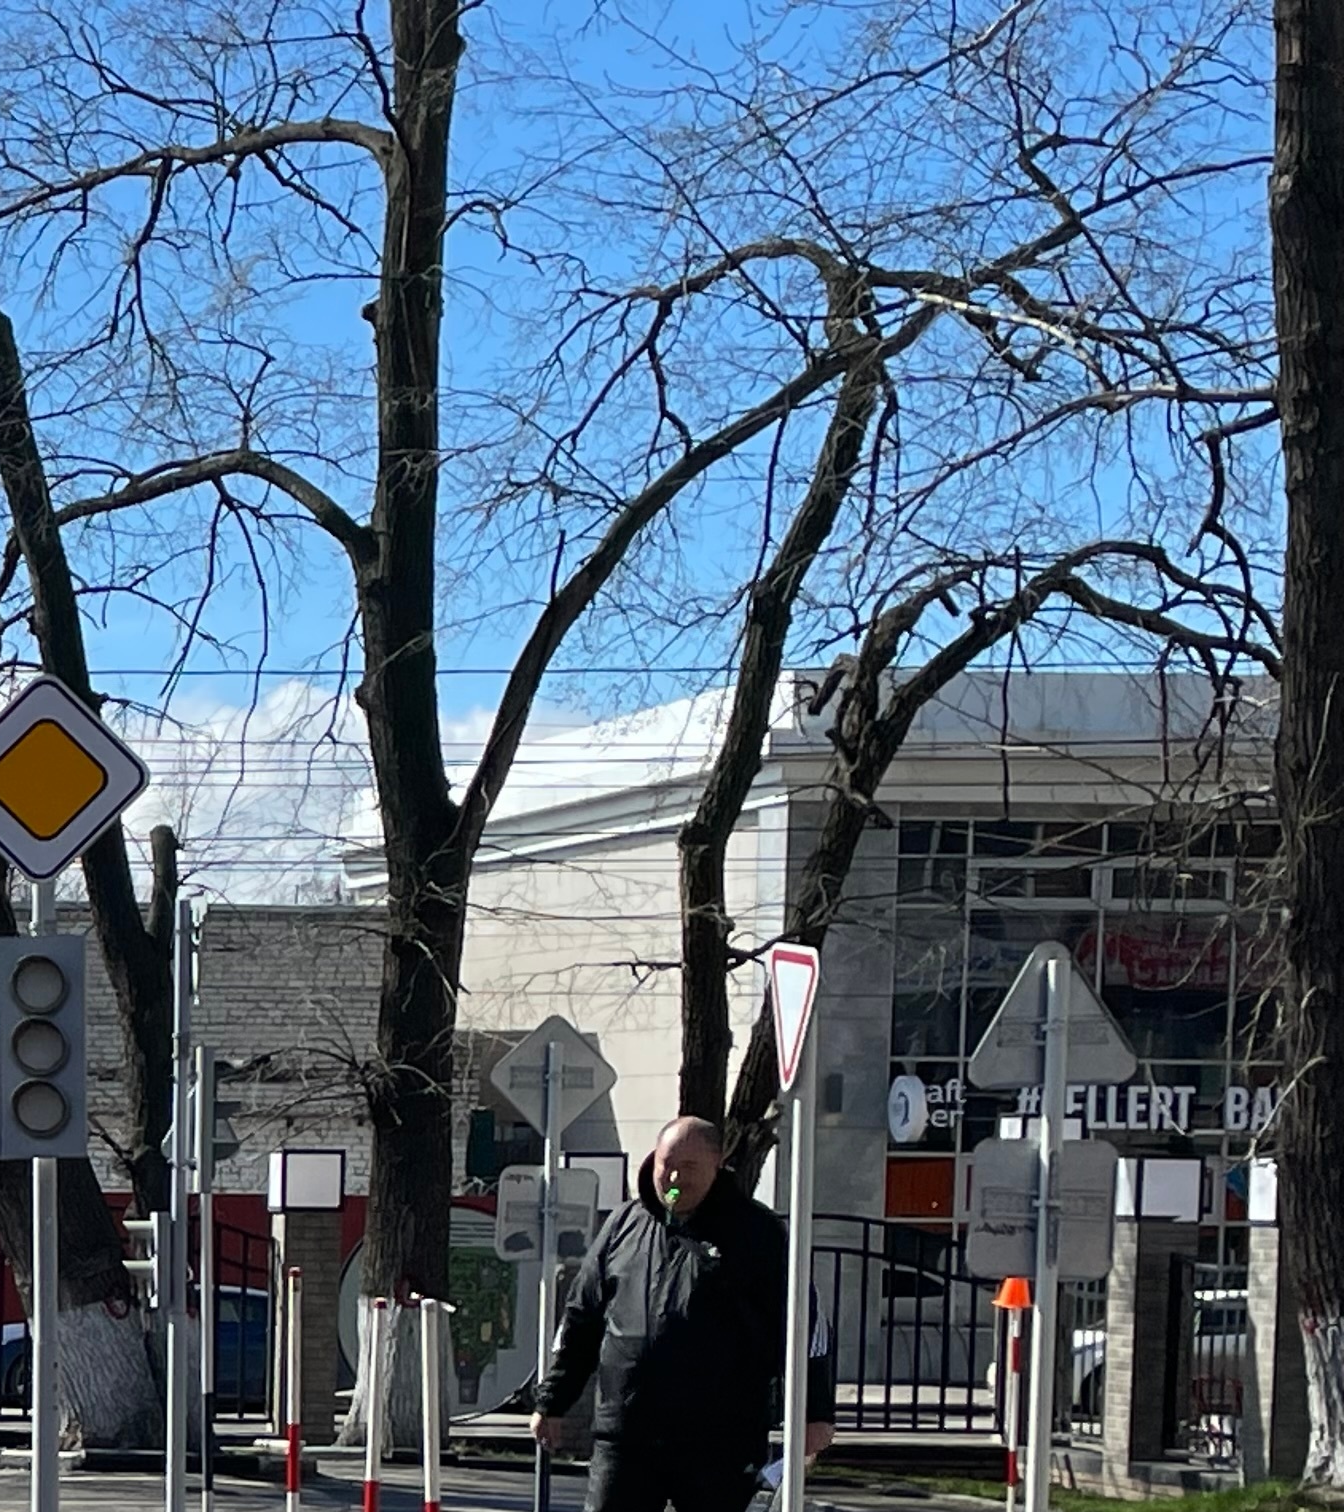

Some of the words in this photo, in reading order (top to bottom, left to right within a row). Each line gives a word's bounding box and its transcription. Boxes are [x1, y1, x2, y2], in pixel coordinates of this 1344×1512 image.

[924, 1078, 967, 1103] aft
[924, 1109, 964, 1128] er
[1016, 1085, 1196, 1130] #ELLERT
[1223, 1085, 1282, 1131] BA
